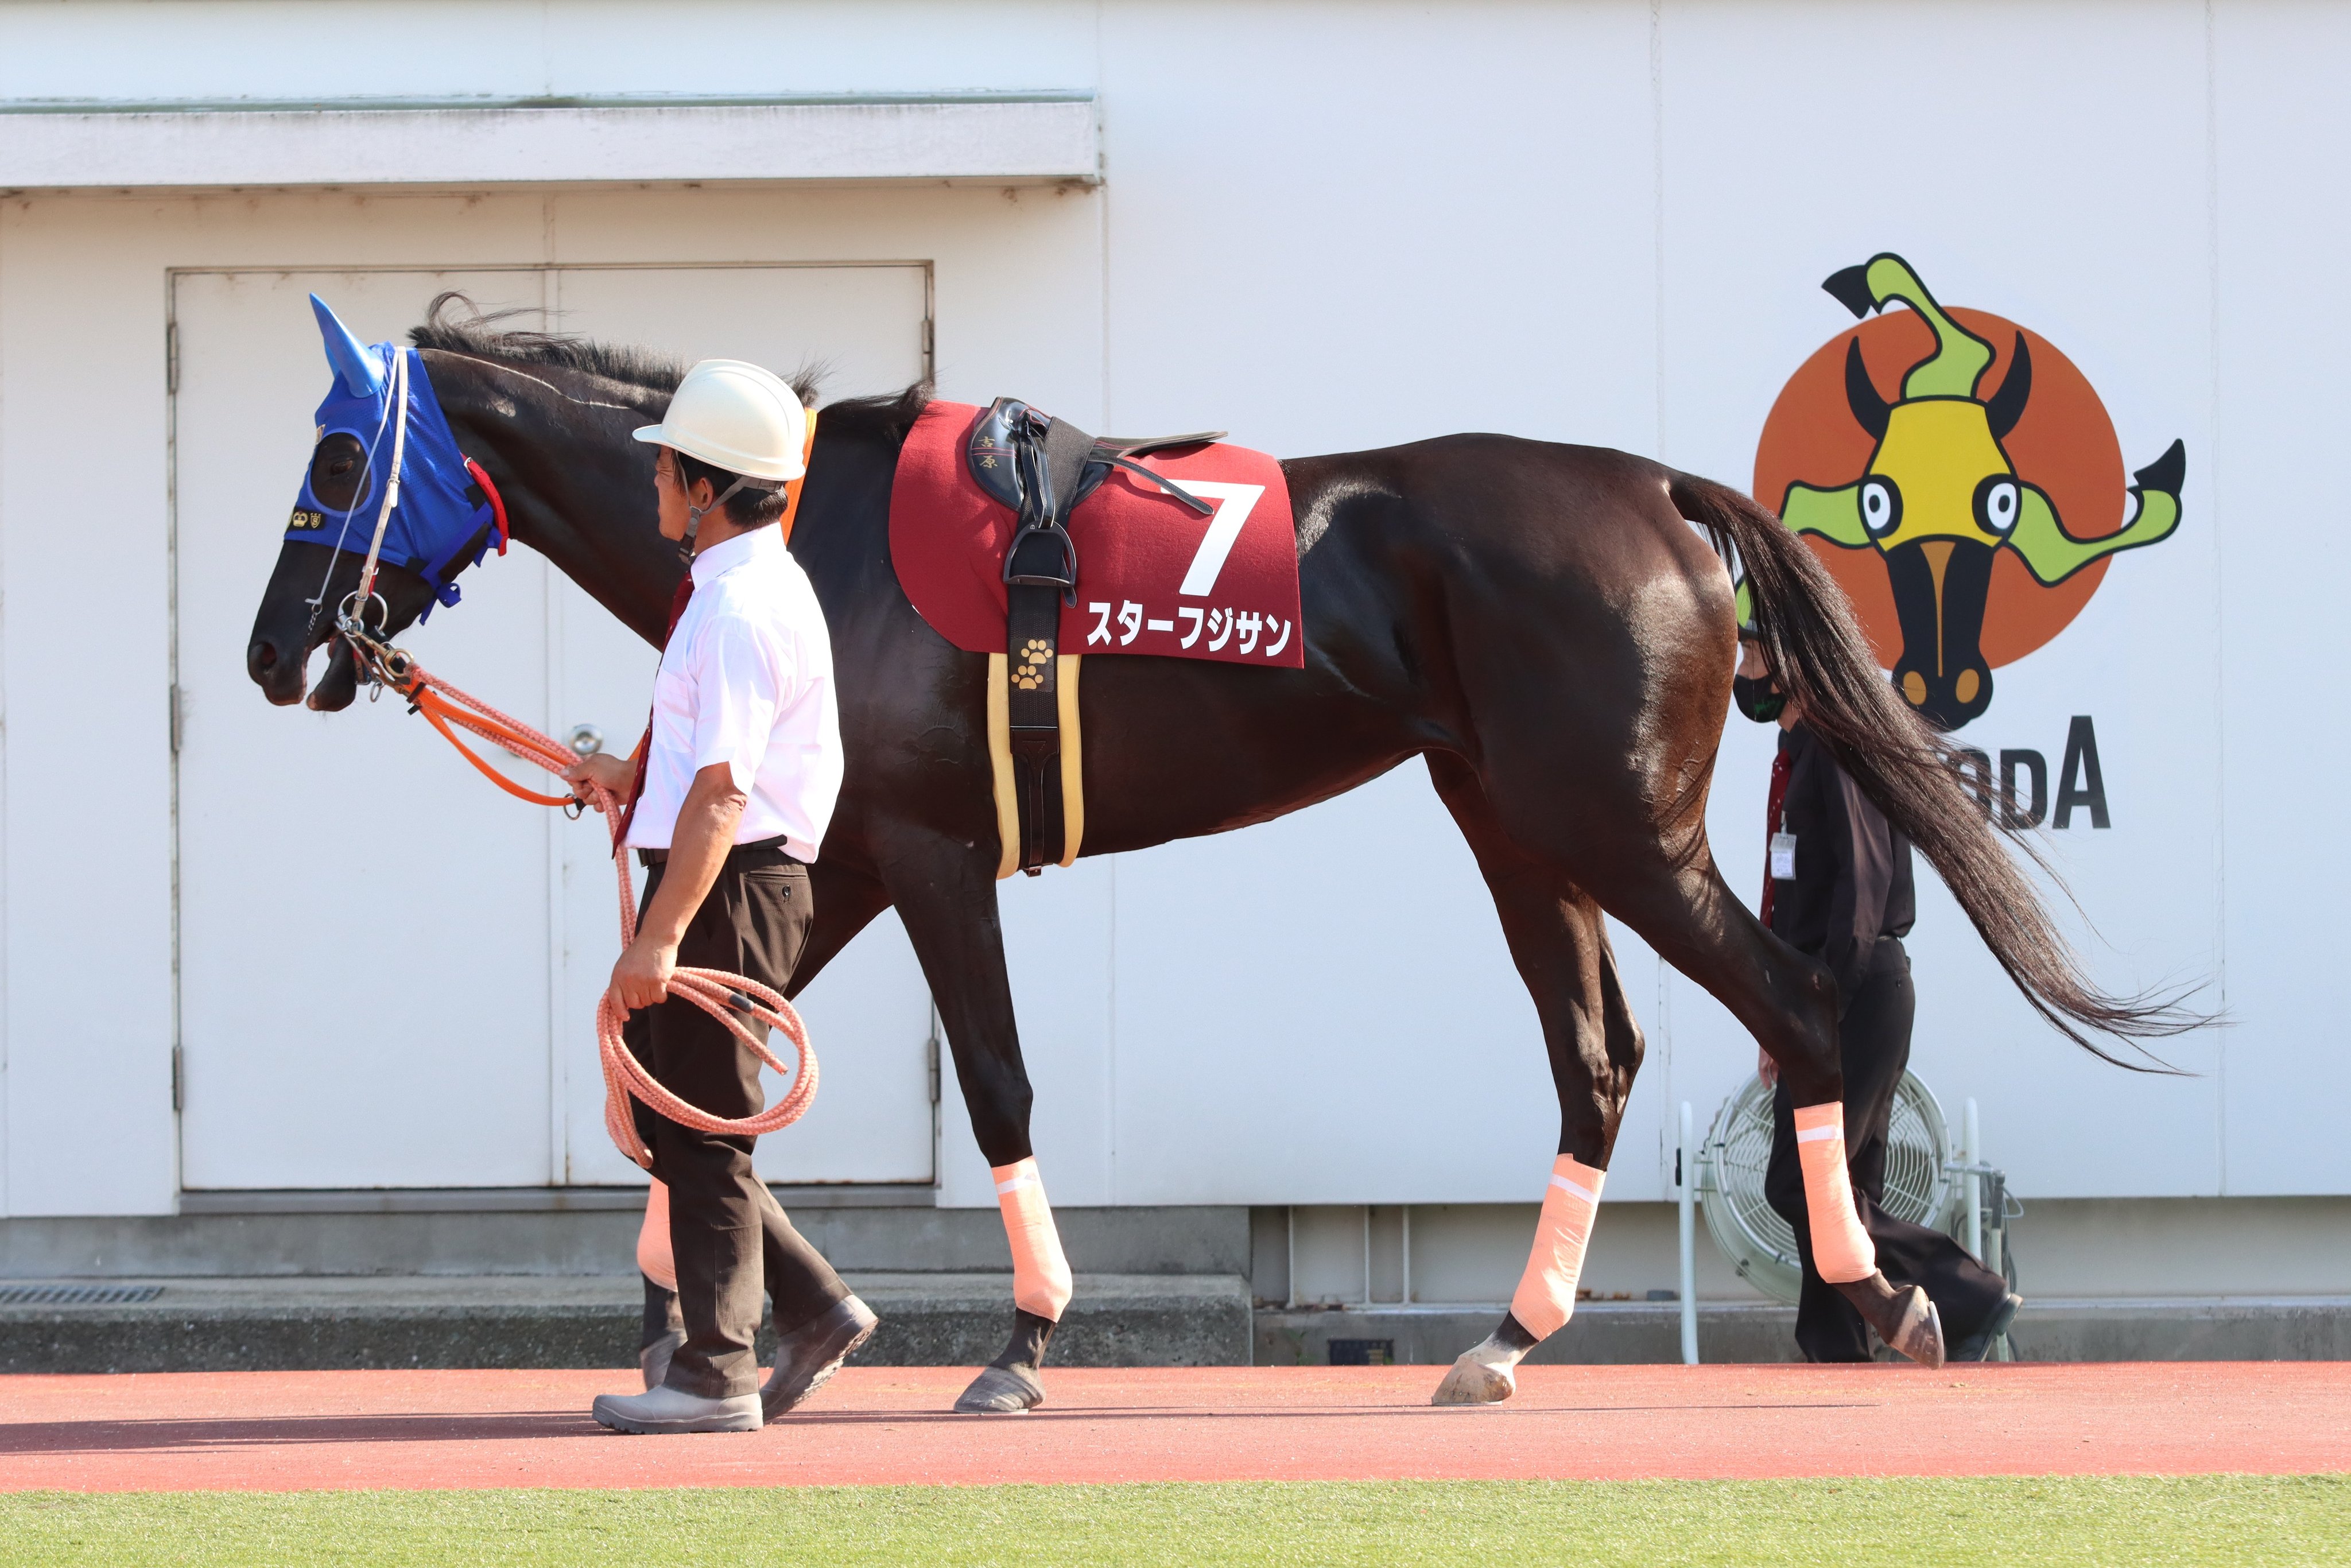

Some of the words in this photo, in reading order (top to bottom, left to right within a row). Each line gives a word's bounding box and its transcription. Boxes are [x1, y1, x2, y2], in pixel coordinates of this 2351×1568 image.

[977, 436, 998, 469] 吉原
[1159, 478, 1266, 597] 7
[1087, 599, 1292, 657] スターフジサン
[1947, 715, 2112, 830] ODA
